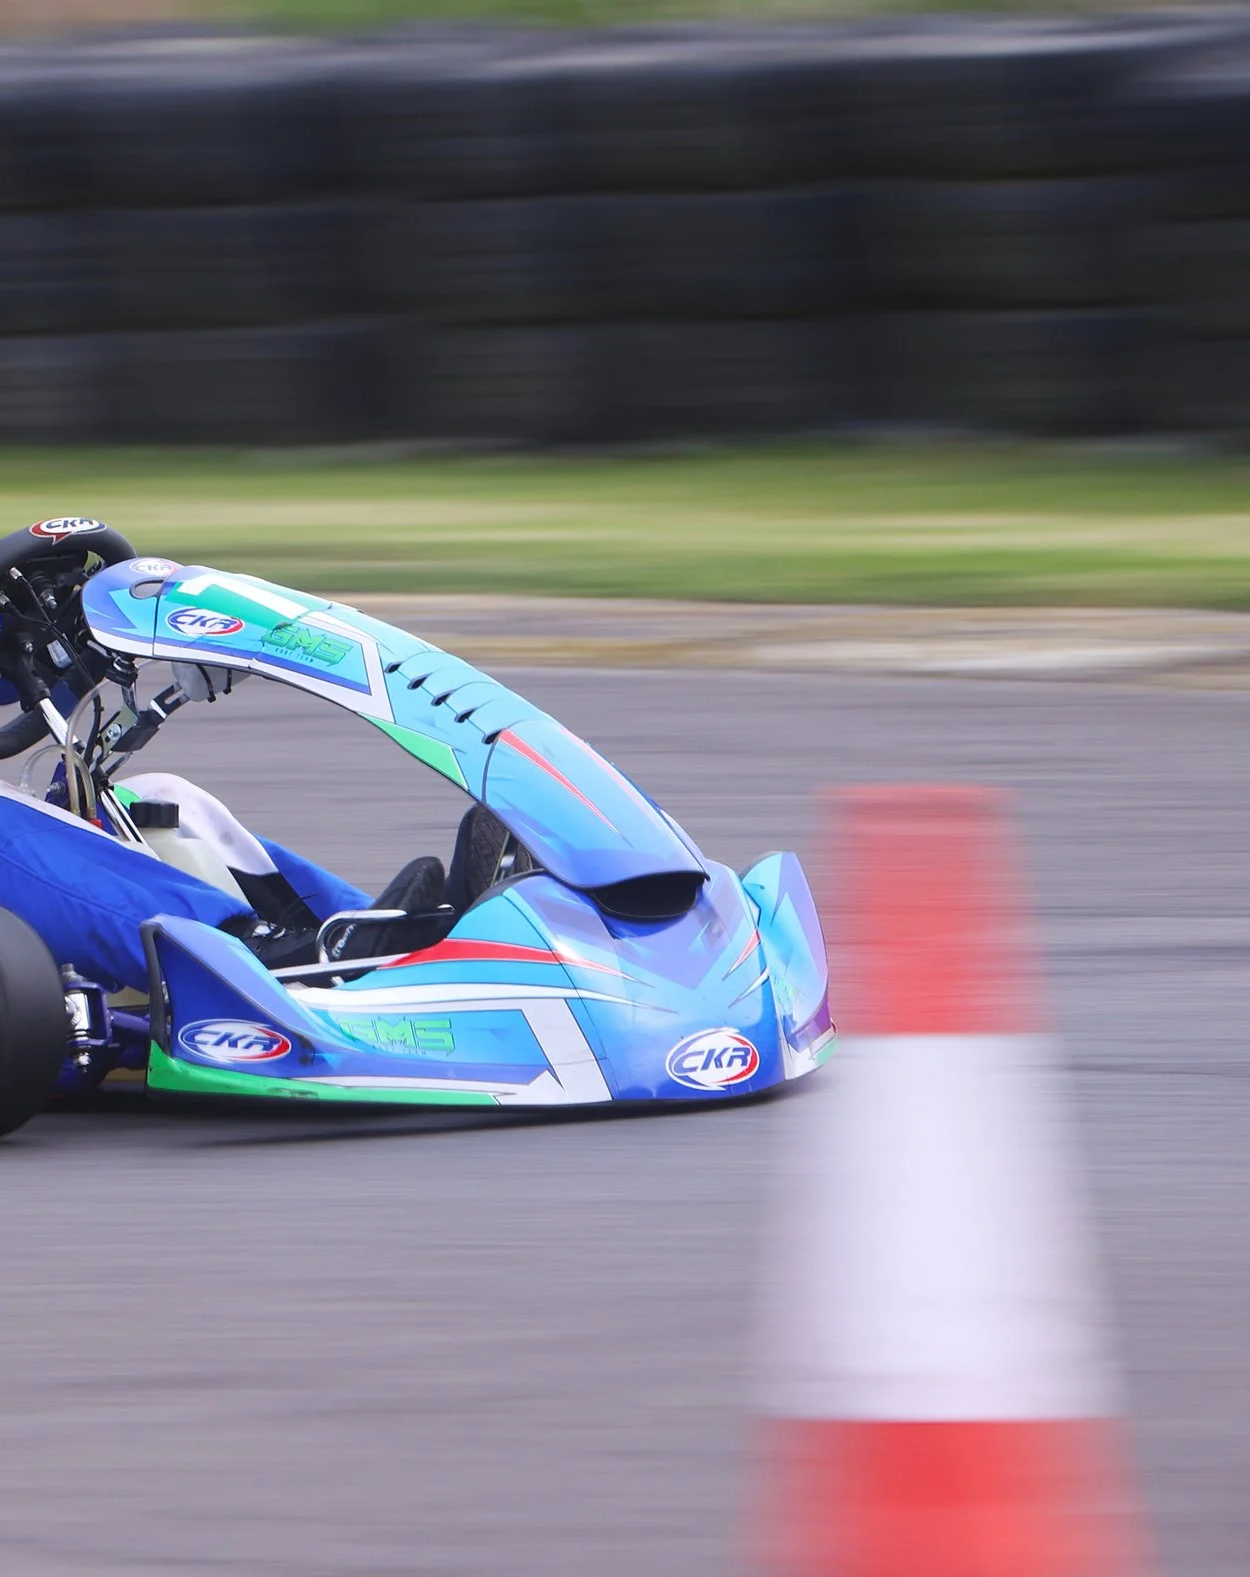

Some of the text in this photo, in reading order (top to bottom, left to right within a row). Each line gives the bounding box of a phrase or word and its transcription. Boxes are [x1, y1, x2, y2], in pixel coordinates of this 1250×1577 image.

[169, 613, 239, 629] CKR
[261, 625, 354, 665] GMS
[183, 1029, 282, 1051] CKR
[672, 1047, 751, 1075] CKR
